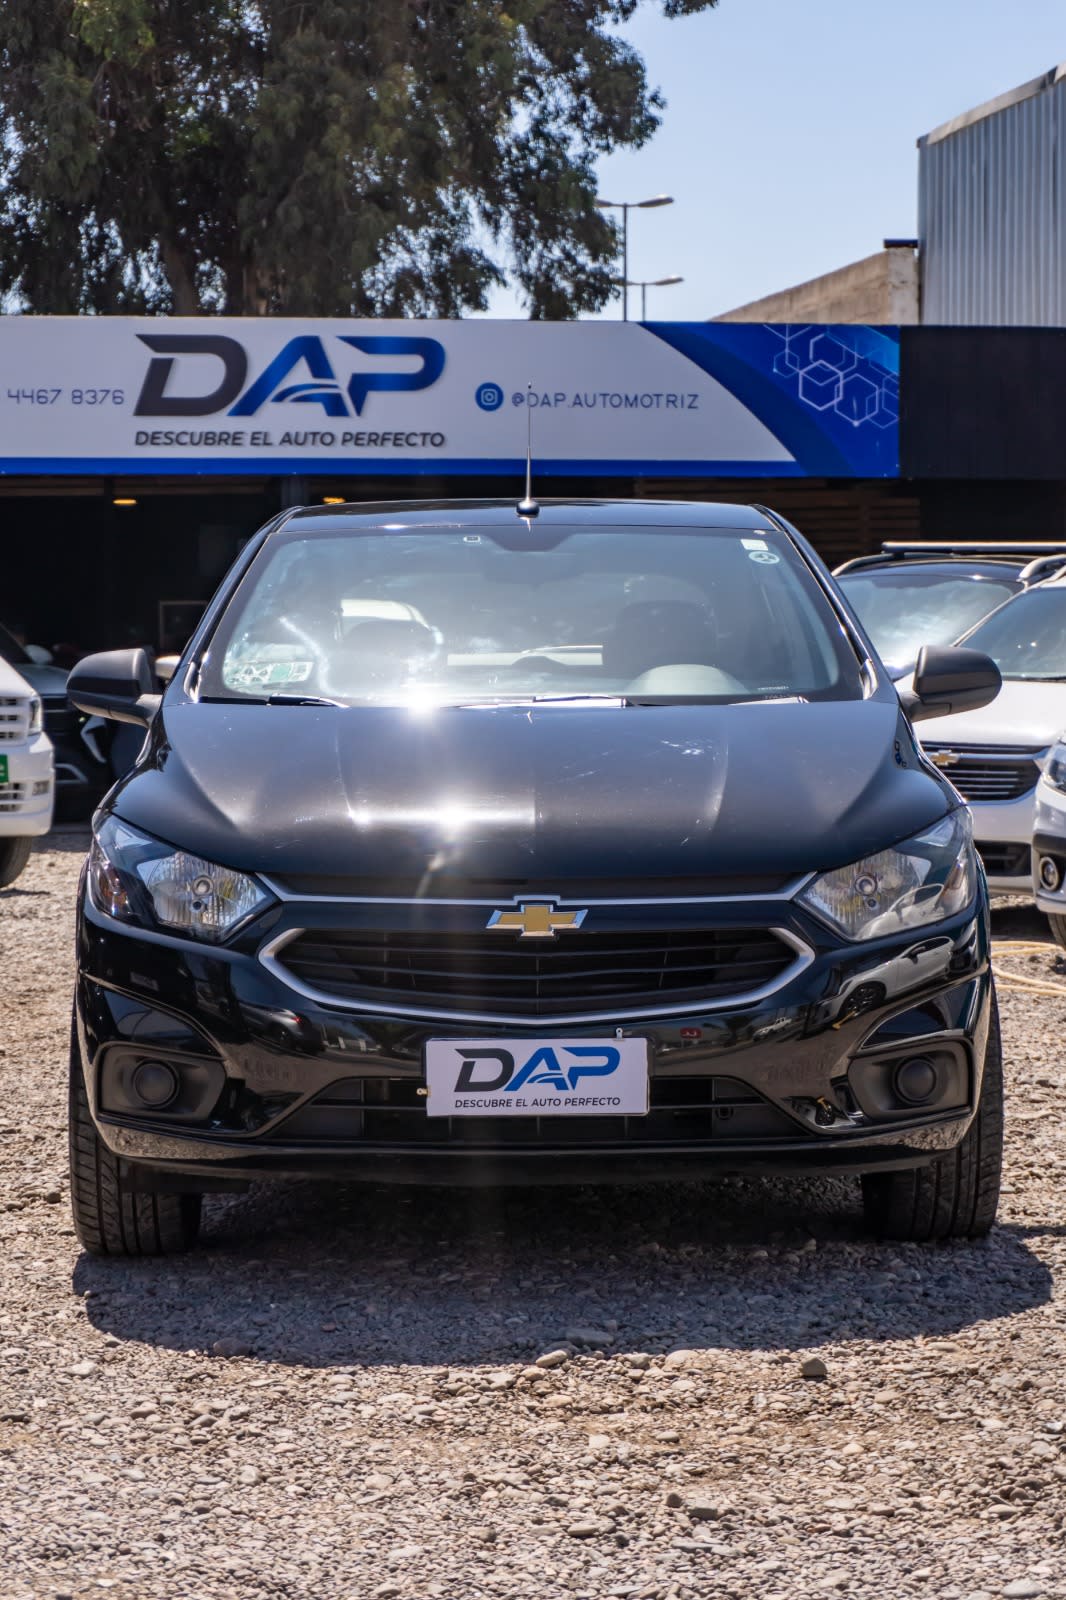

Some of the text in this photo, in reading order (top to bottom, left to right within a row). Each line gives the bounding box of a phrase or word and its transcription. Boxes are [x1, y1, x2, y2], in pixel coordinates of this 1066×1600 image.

[133, 334, 446, 417] DAP
[7, 388, 125, 405] 4467 8376
[134, 431, 446, 448] DESCUBRE EL AUTO PERFECTO
[453, 1046, 621, 1093] DAP
[454, 1096, 621, 1109] DESCUBRE EL AUTO PERFECTO
